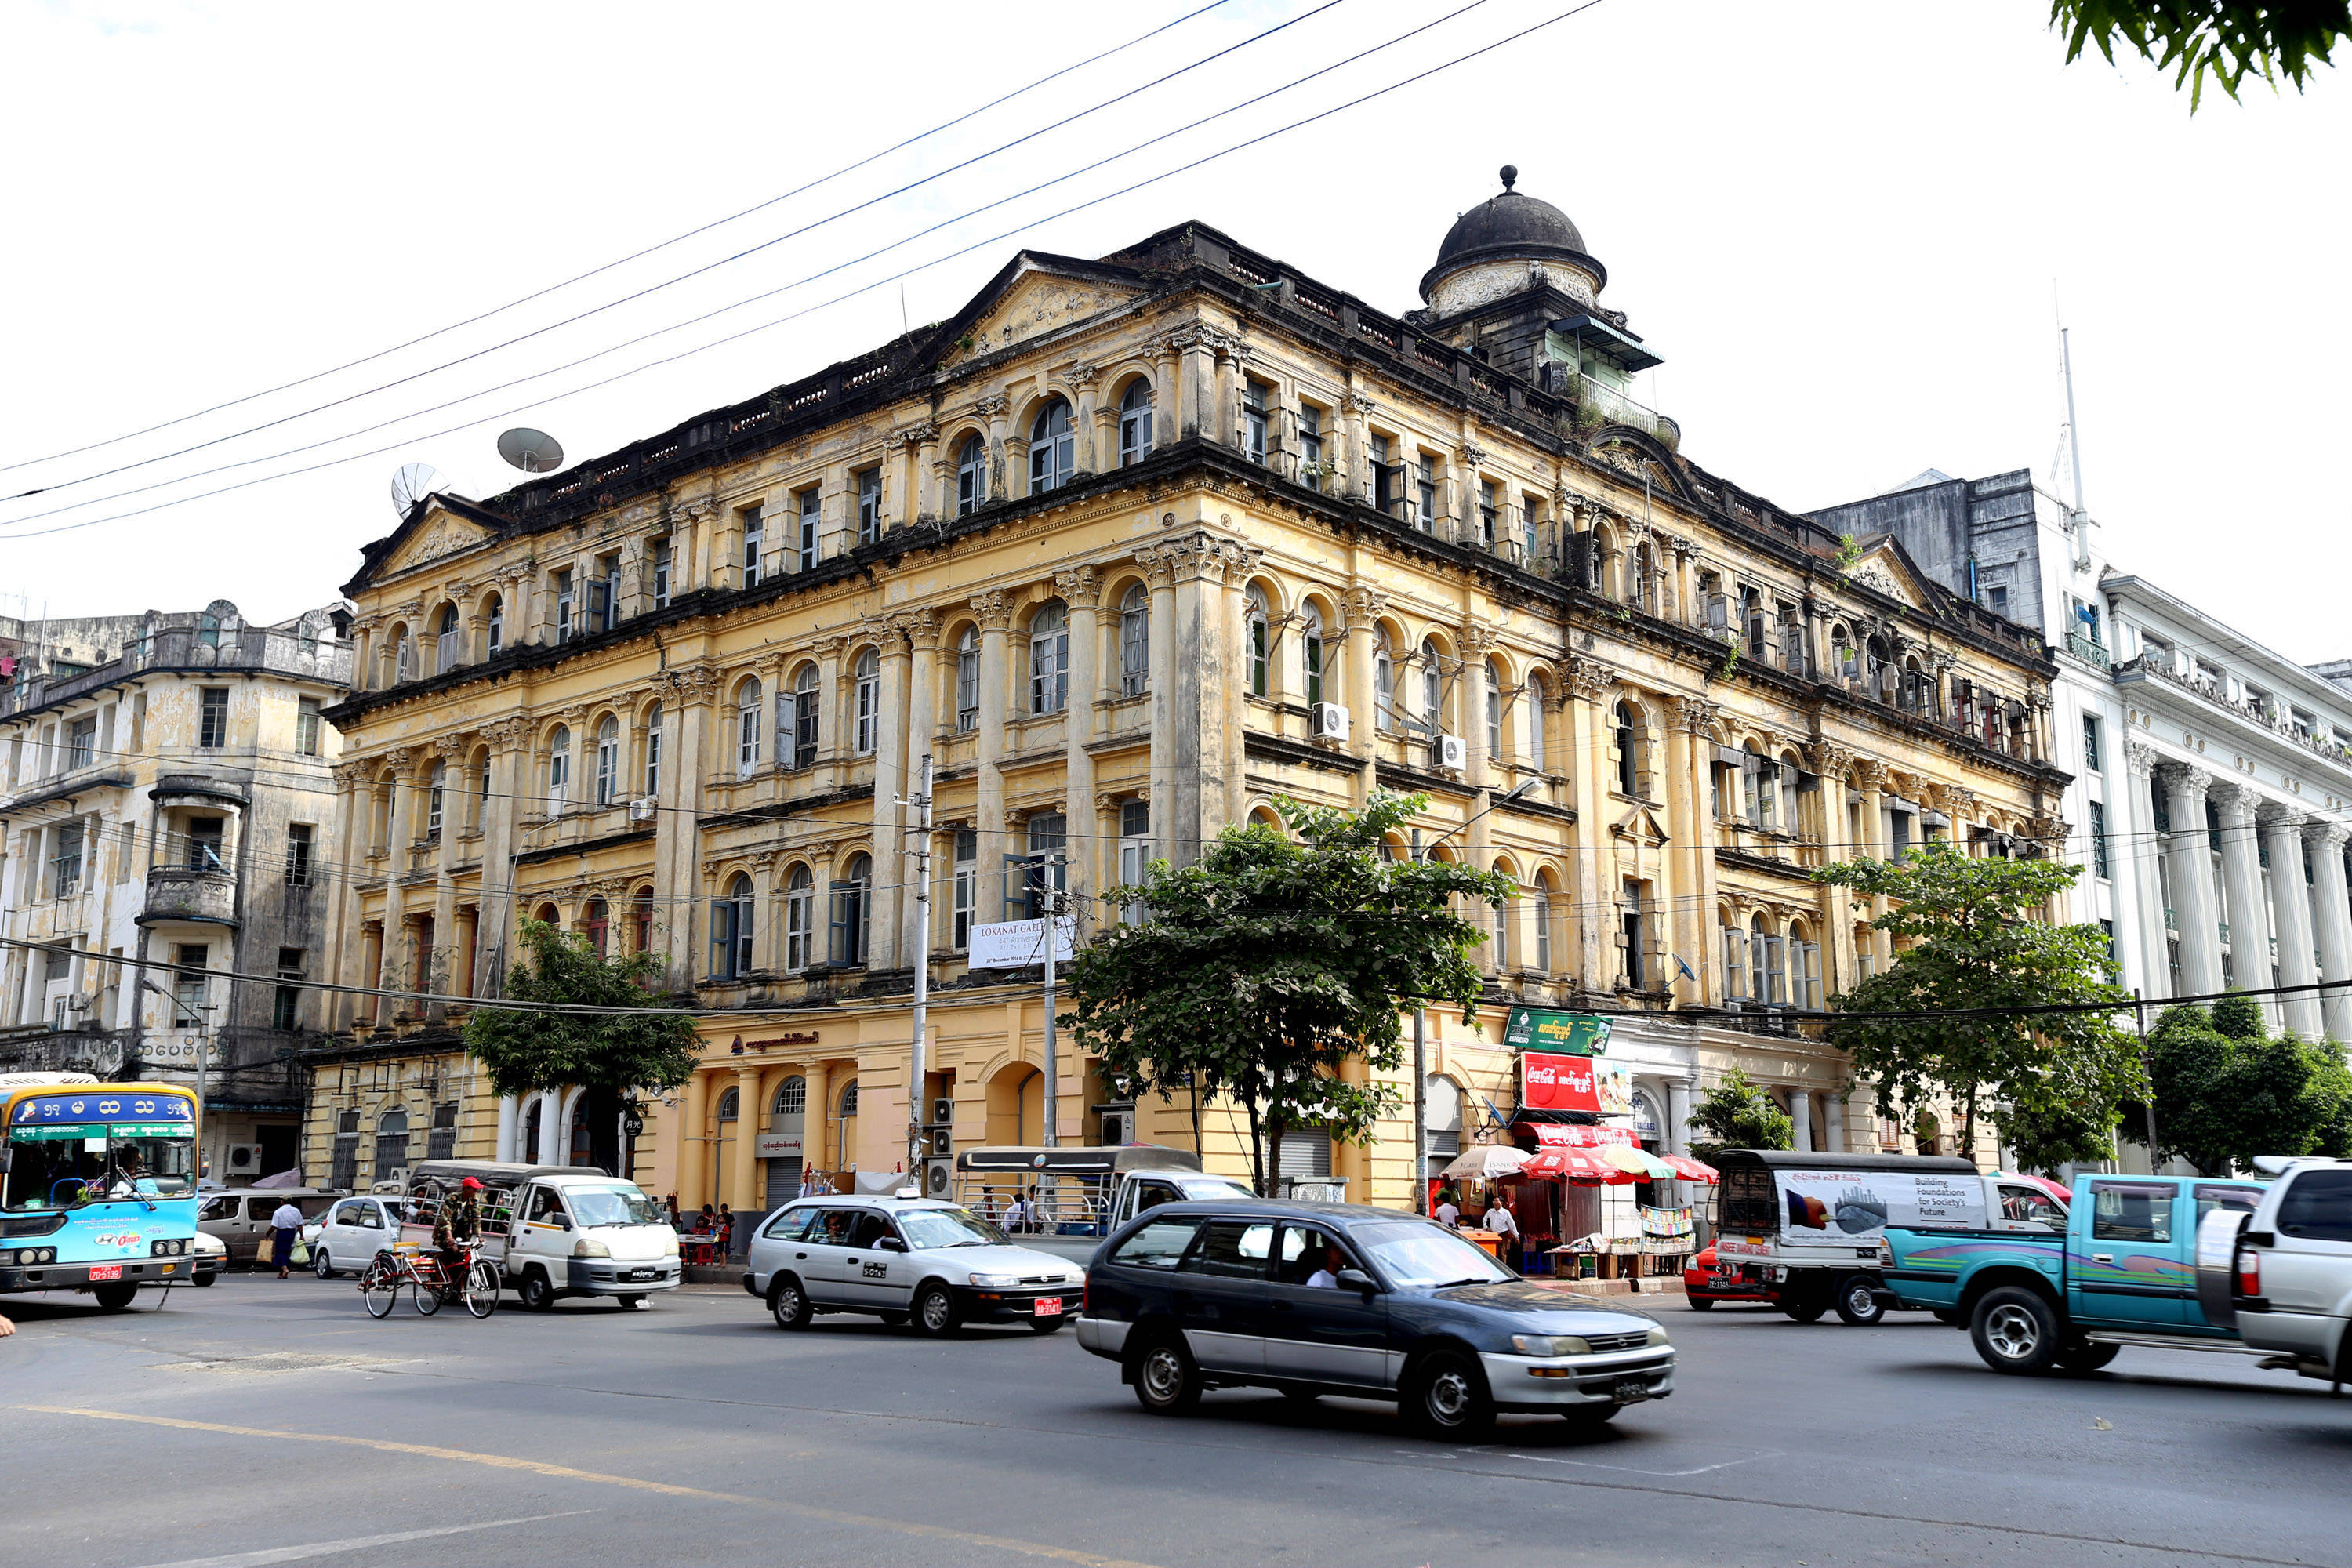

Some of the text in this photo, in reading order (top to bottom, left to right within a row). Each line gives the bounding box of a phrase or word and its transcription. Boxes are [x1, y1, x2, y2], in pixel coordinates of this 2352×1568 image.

[982, 924, 1018, 937] LOKANAT
[1527, 1066, 1555, 1085] Coca-Cola
[626, 1120, 641, 1129] 月光
[1915, 1178, 1948, 1188] Building
[1917, 1188, 1965, 1196] Foundations
[1931, 1197, 1965, 1208] Society's
[1919, 1207, 1945, 1216] Future
